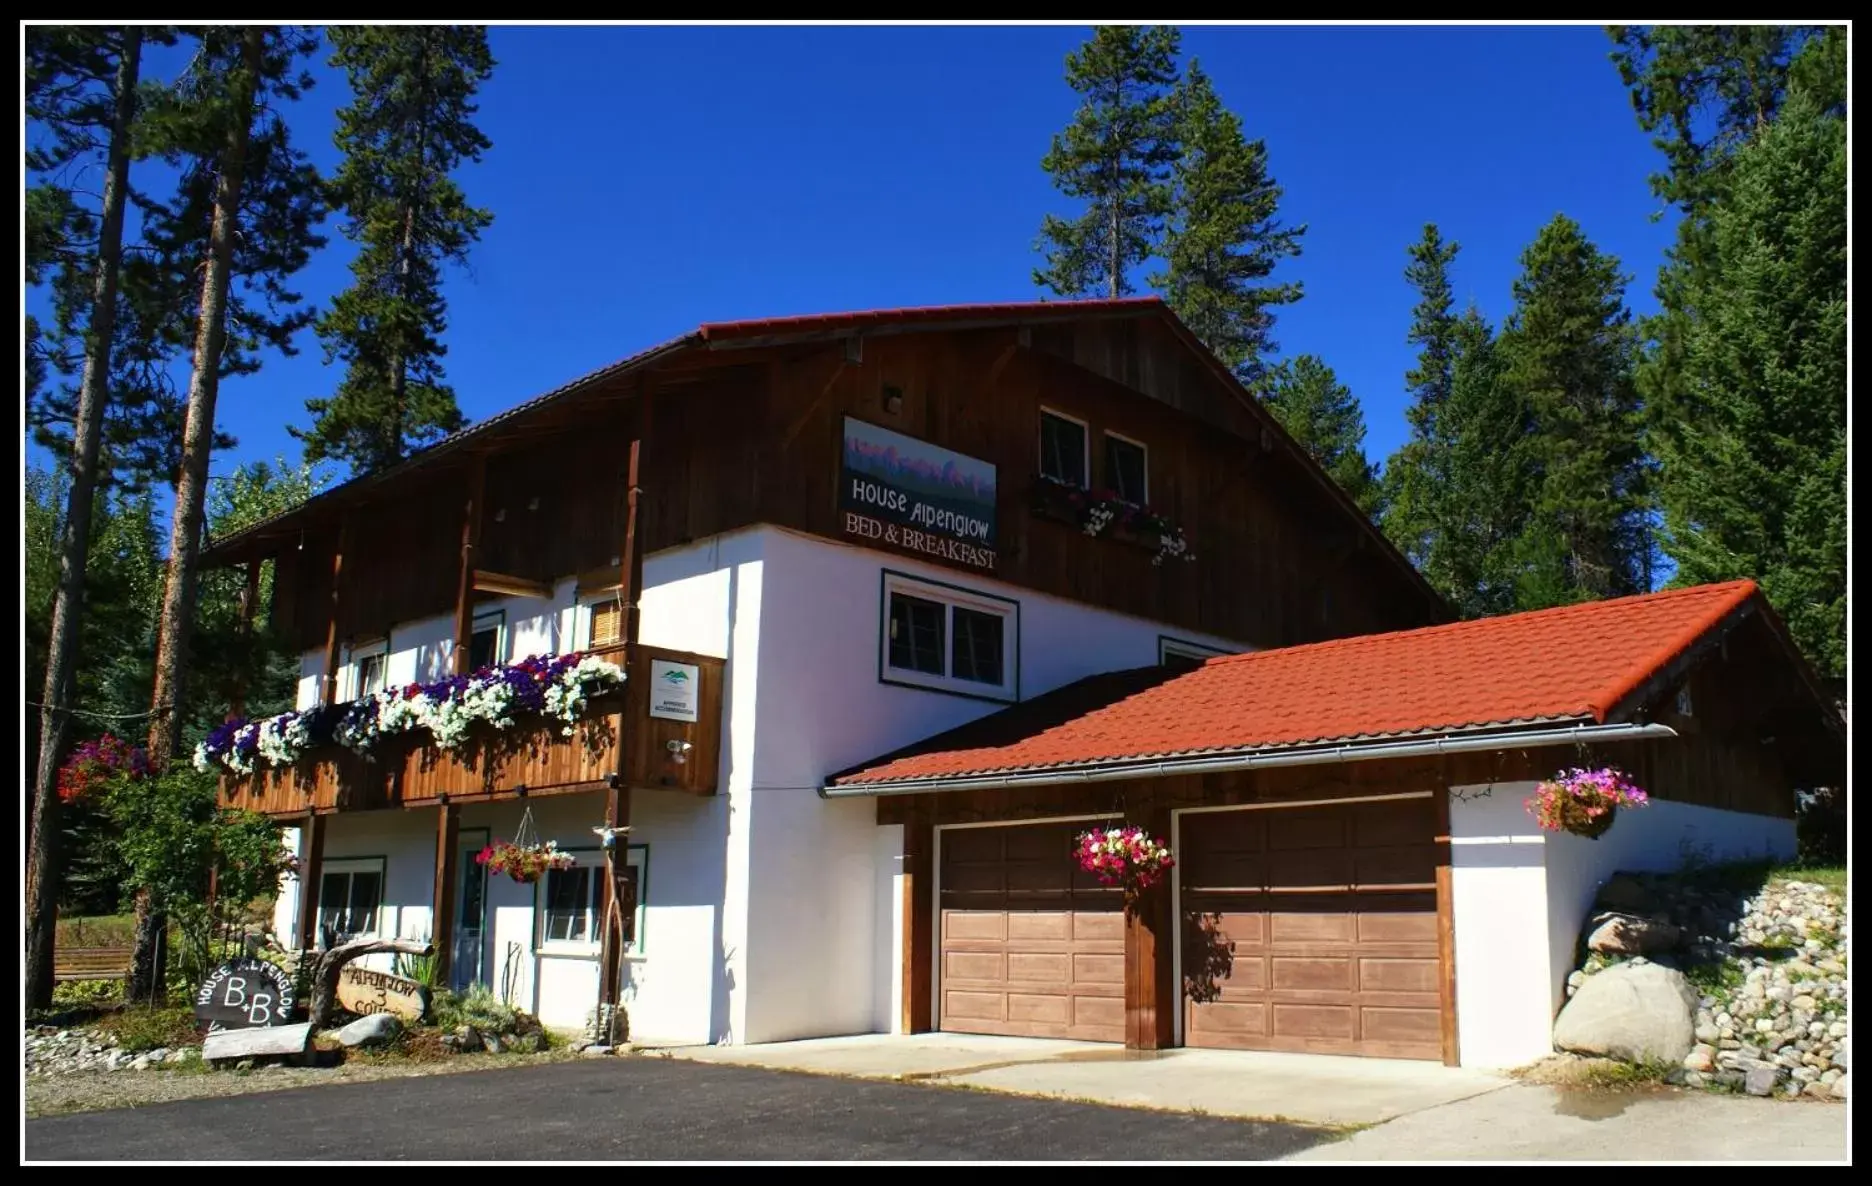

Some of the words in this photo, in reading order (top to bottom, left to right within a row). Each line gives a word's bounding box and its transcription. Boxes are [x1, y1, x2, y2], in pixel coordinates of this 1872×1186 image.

[845, 512, 882, 539] BED
[885, 523, 898, 544] &
[903, 527, 996, 569] BREAKFAST
[197, 965, 232, 1006] HOUSE
[236, 959, 293, 1018] LPENGLOW
[371, 987, 387, 1007] 3
